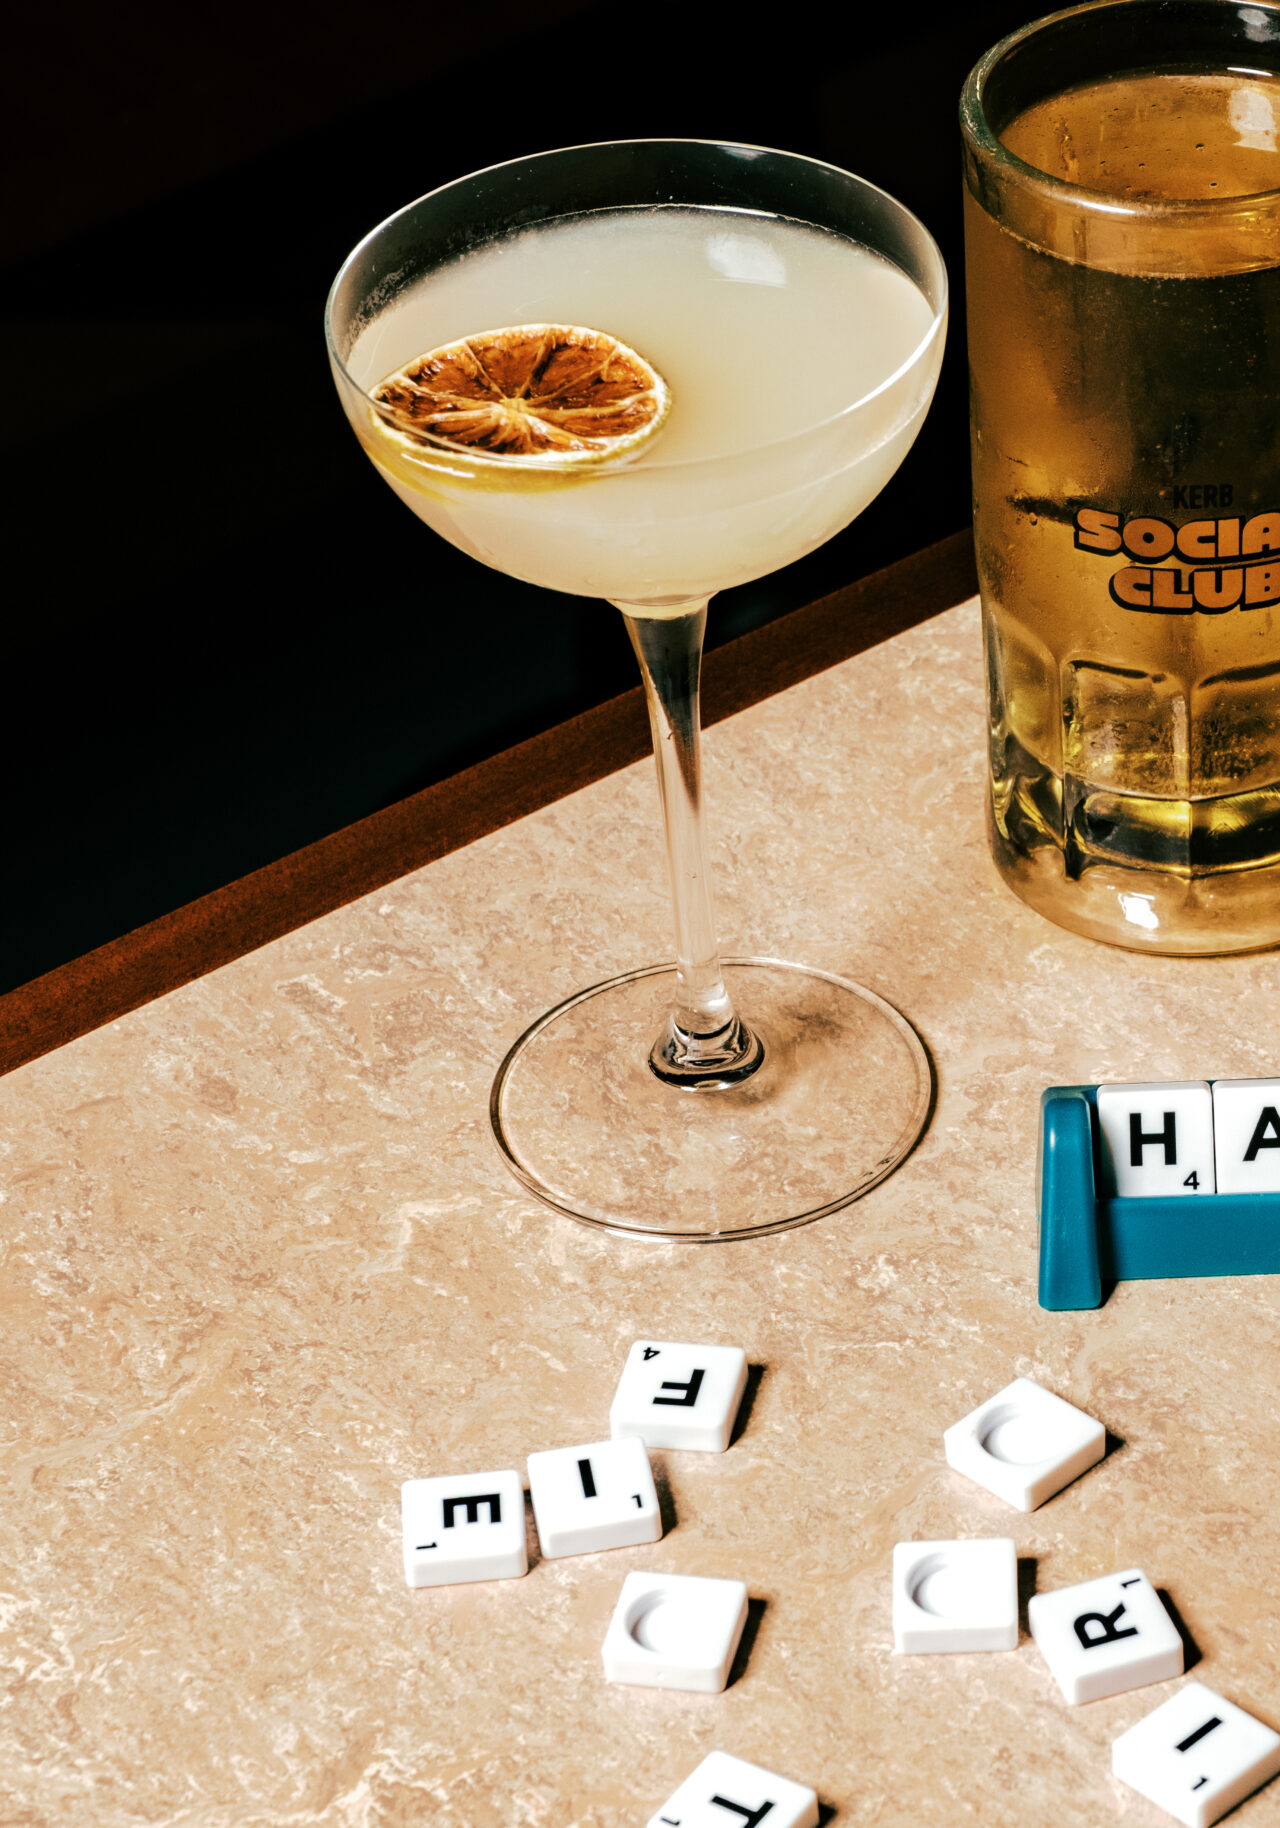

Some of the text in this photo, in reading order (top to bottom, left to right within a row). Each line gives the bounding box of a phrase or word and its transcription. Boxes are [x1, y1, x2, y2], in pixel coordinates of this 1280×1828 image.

[1173, 484, 1234, 509] KERB
[1182, 1170, 1200, 1190] 4
[642, 1346, 661, 1361] 4
[652, 1368, 706, 1407] F
[577, 1458, 598, 1499] I
[442, 1493, 502, 1529] E
[631, 1494, 643, 1509] 1
[415, 1541, 438, 1550] 1
[1120, 1577, 1142, 1589] 1
[1073, 1602, 1139, 1650] R
[1175, 1716, 1223, 1753] I
[1192, 1775, 1209, 1791] 1
